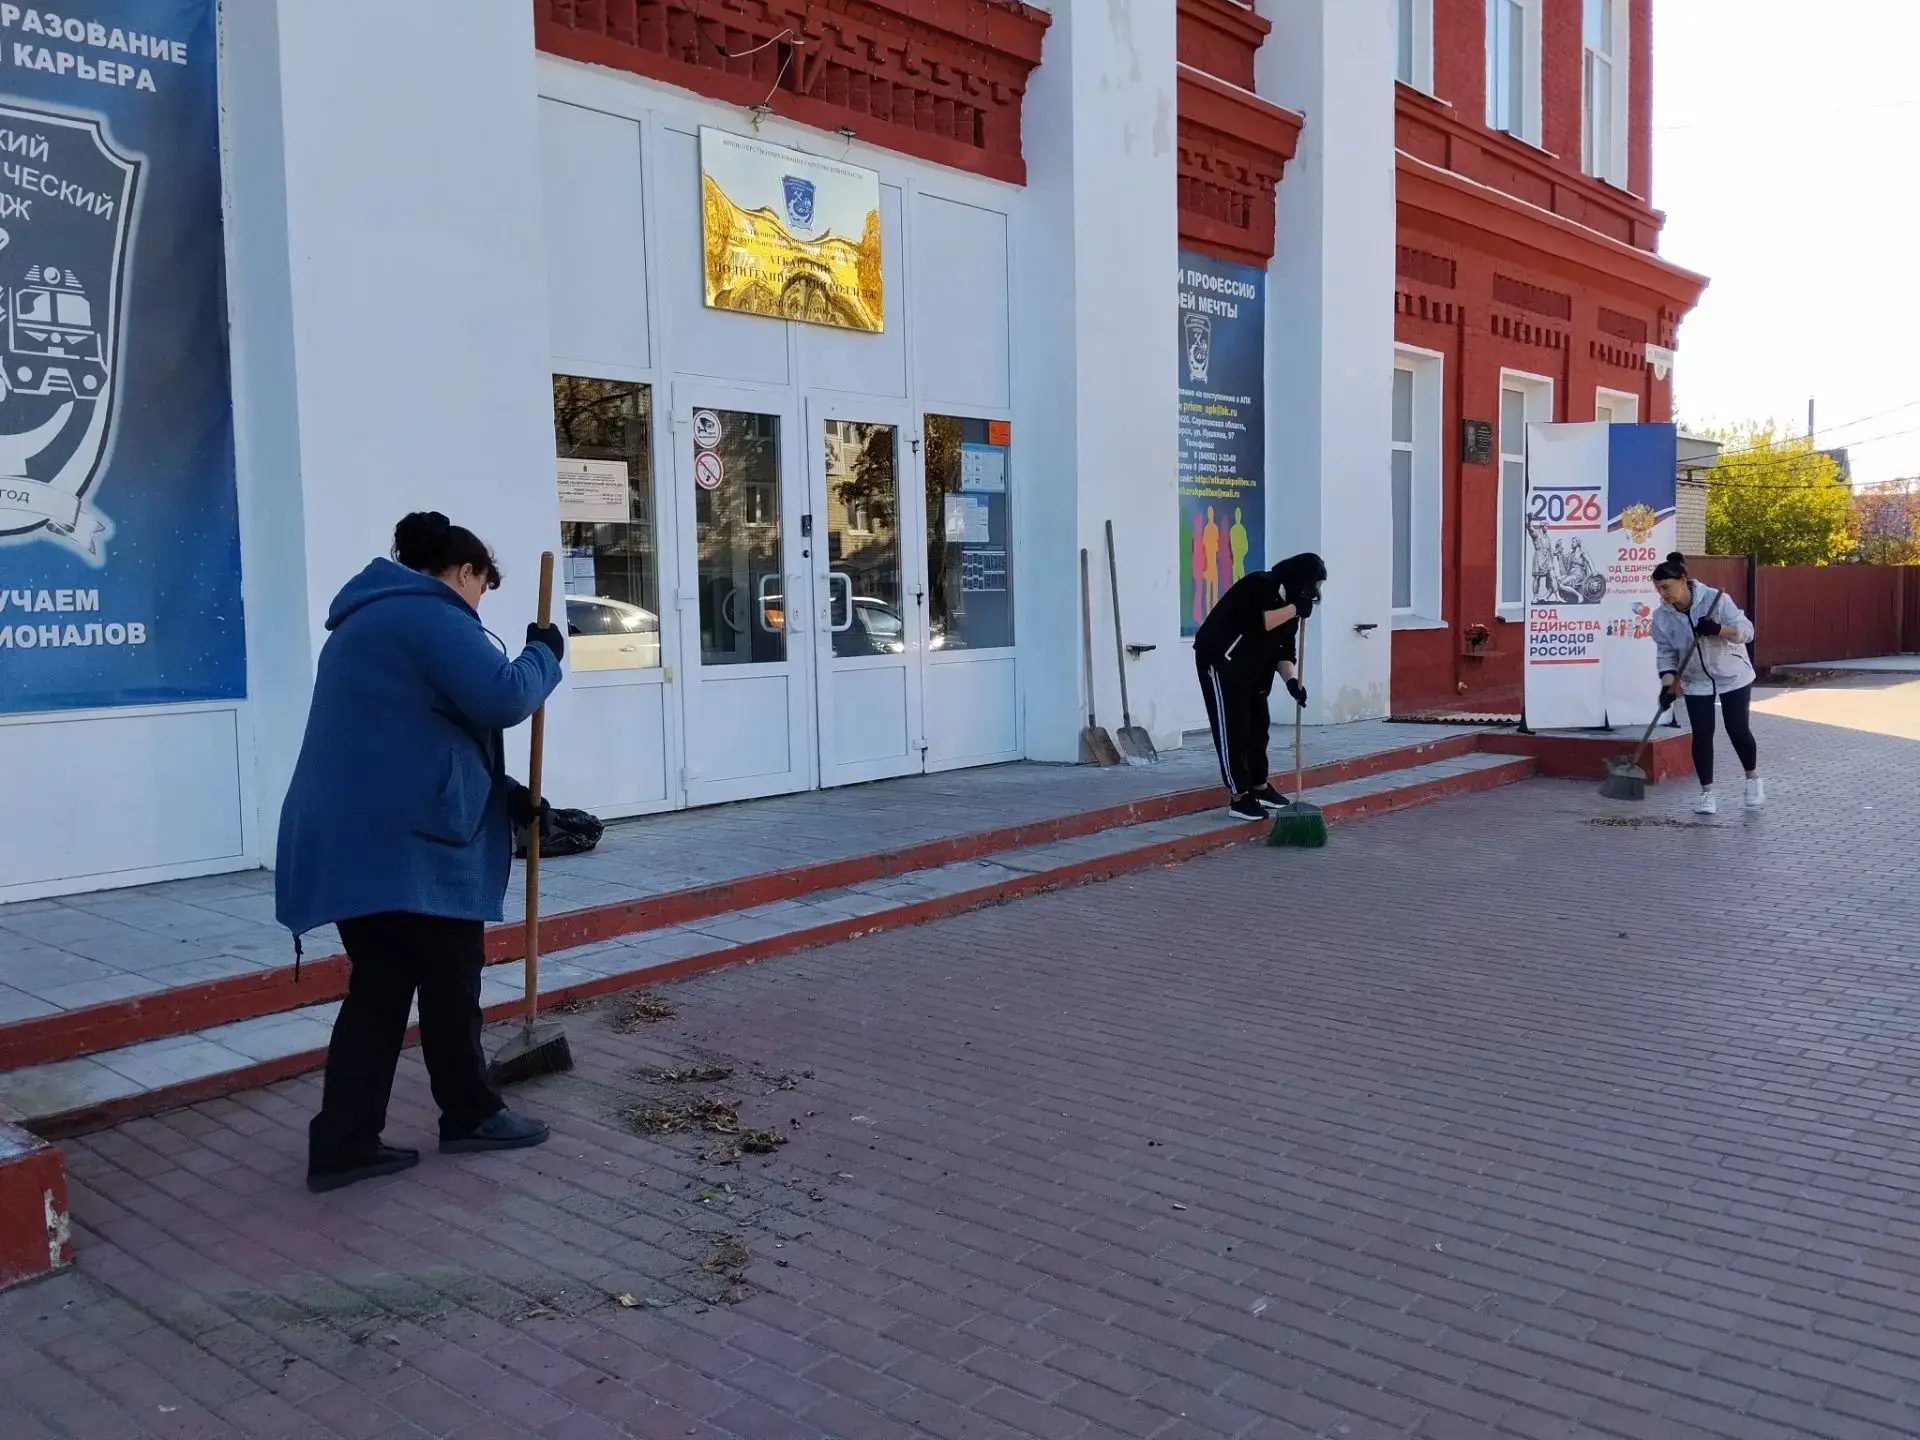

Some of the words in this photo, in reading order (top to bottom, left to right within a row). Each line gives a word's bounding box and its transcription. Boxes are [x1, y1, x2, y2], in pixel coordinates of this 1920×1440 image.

[1, 2, 188, 65] РАЗОВАНИЕ
[13, 41, 156, 93] КАРЬЕРА
[4, 161, 114, 221] ЧЕСКИЙ
[1187, 270, 1256, 300] ПРОФЕССИЮ
[1198, 296, 1238, 319] МЕЧТЫ
[1228, 431, 1235, 440] 97
[1531, 493, 1602, 522] 2026
[1618, 547, 1656, 561] 2026
[1530, 609, 1558, 620] ГОД
[1530, 620, 1602, 633] ЕДИНСТВА
[1530, 633, 1595, 645] НАРОДОВ
[1529, 646, 1586, 657] РОССИИ
